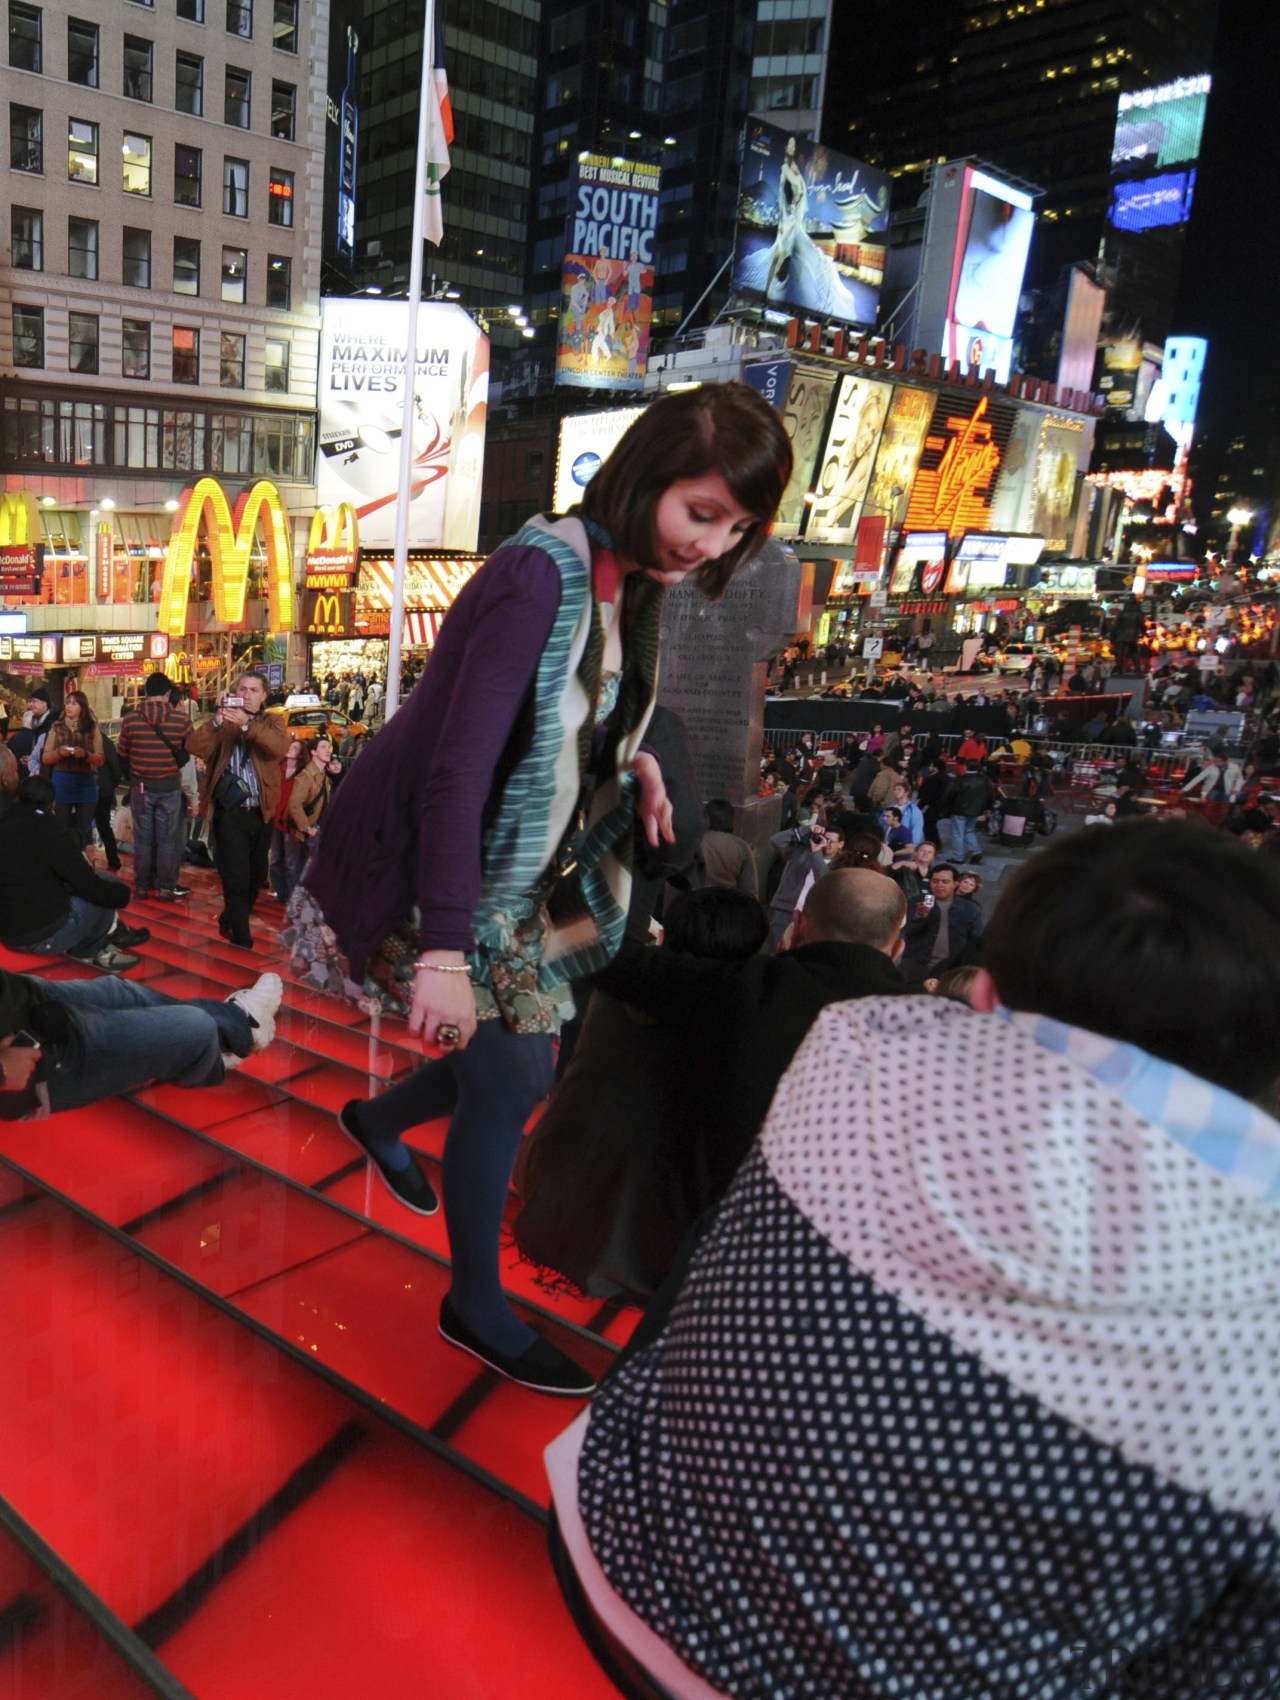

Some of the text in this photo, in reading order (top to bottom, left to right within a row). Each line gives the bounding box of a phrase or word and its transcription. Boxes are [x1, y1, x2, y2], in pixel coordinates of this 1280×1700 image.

[579, 165, 660, 191] BEST MUSICAL REVIVAL
[575, 184, 659, 229] SOUTH
[572, 218, 655, 264] PACIFIC
[334, 334, 388, 345] WHERE
[332, 344, 449, 364] MAXIMUM
[331, 362, 448, 376] PERFORMNCE
[330, 375, 397, 392] LIVES
[334, 440, 354, 451] DVD
[307, 555, 354, 566] McDonald's
[725, 589, 766, 600] DUFFY
[102, 643, 143, 652] INFORMATION
[111, 652, 135, 660] CENTER
[676, 673, 693, 681] LIFE
[706, 674, 742, 683] SERVICE
[662, 687, 743, 698] GOD AND COUNTRY
